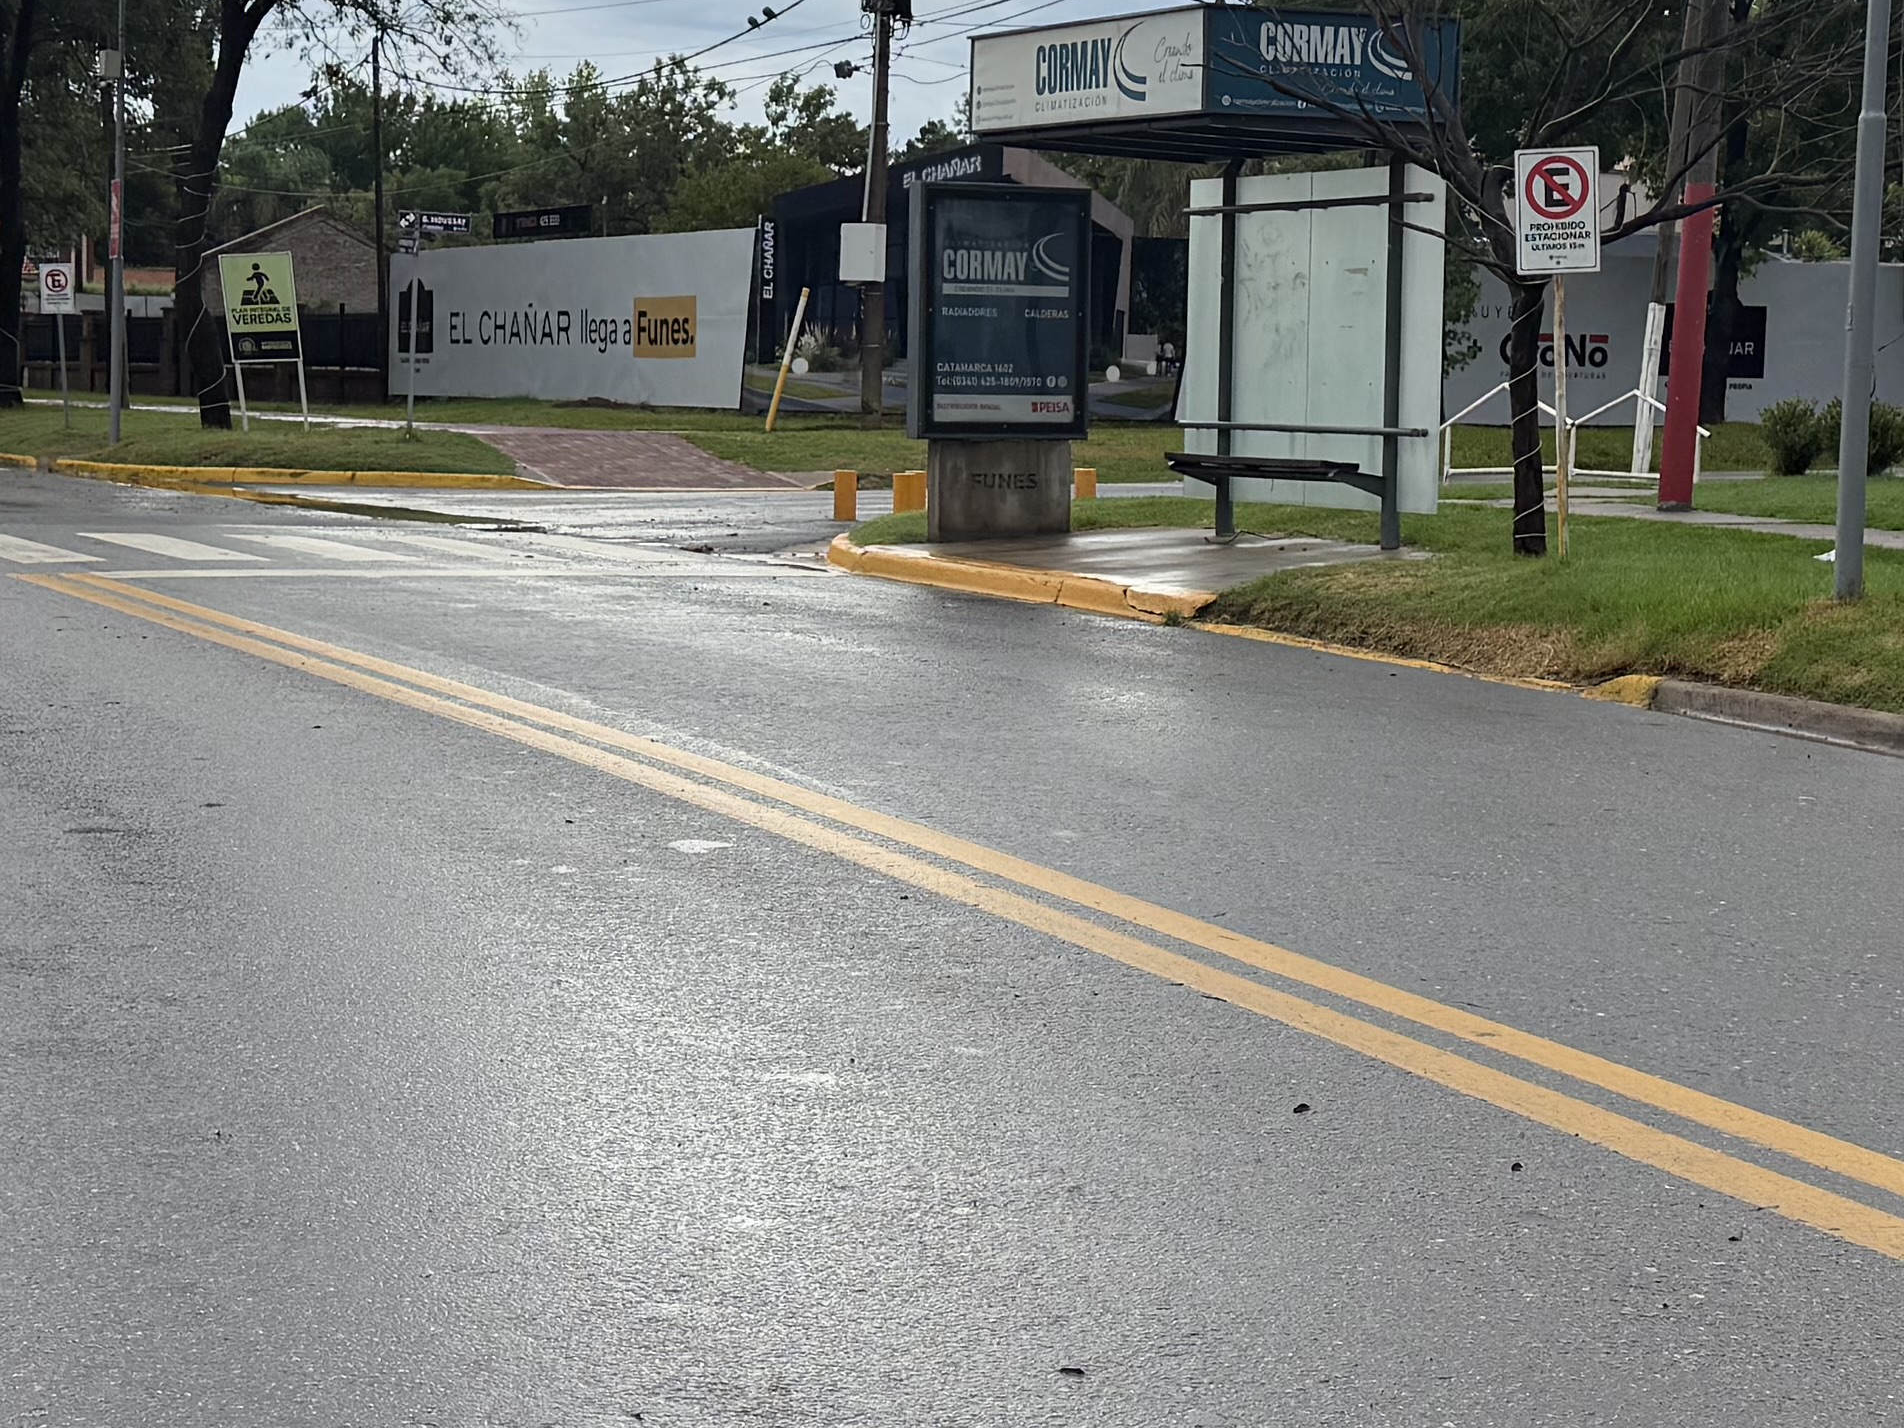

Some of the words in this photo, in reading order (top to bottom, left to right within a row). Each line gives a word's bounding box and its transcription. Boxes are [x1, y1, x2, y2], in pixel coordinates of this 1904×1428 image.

[1259, 21, 1367, 65] CORMAY
[1035, 37, 1112, 96] CORMAY
[1034, 94, 1108, 113] CLIMATIZACIÓN
[1529, 221, 1586, 231] PROHIBIDO
[1524, 231, 1592, 242] ESTACIONAR
[762, 221, 775, 279] CHAÑAR
[943, 249, 1028, 281] CORMAY
[762, 282, 774, 299] EL
[232, 312, 292, 325] VEREDAS
[942, 307, 998, 318] RADIADORES
[1024, 308, 1069, 319] CALDERAS
[449, 311, 472, 344] EL
[479, 303, 571, 345] CHAÑAR
[580, 308, 618, 354] llega
[622, 318, 632, 345] a
[637, 310, 694, 346] Funes.
[936, 362, 993, 373] CATAMARCA
[1039, 401, 1070, 413] PEISA
[972, 472, 1038, 490] FUNES
